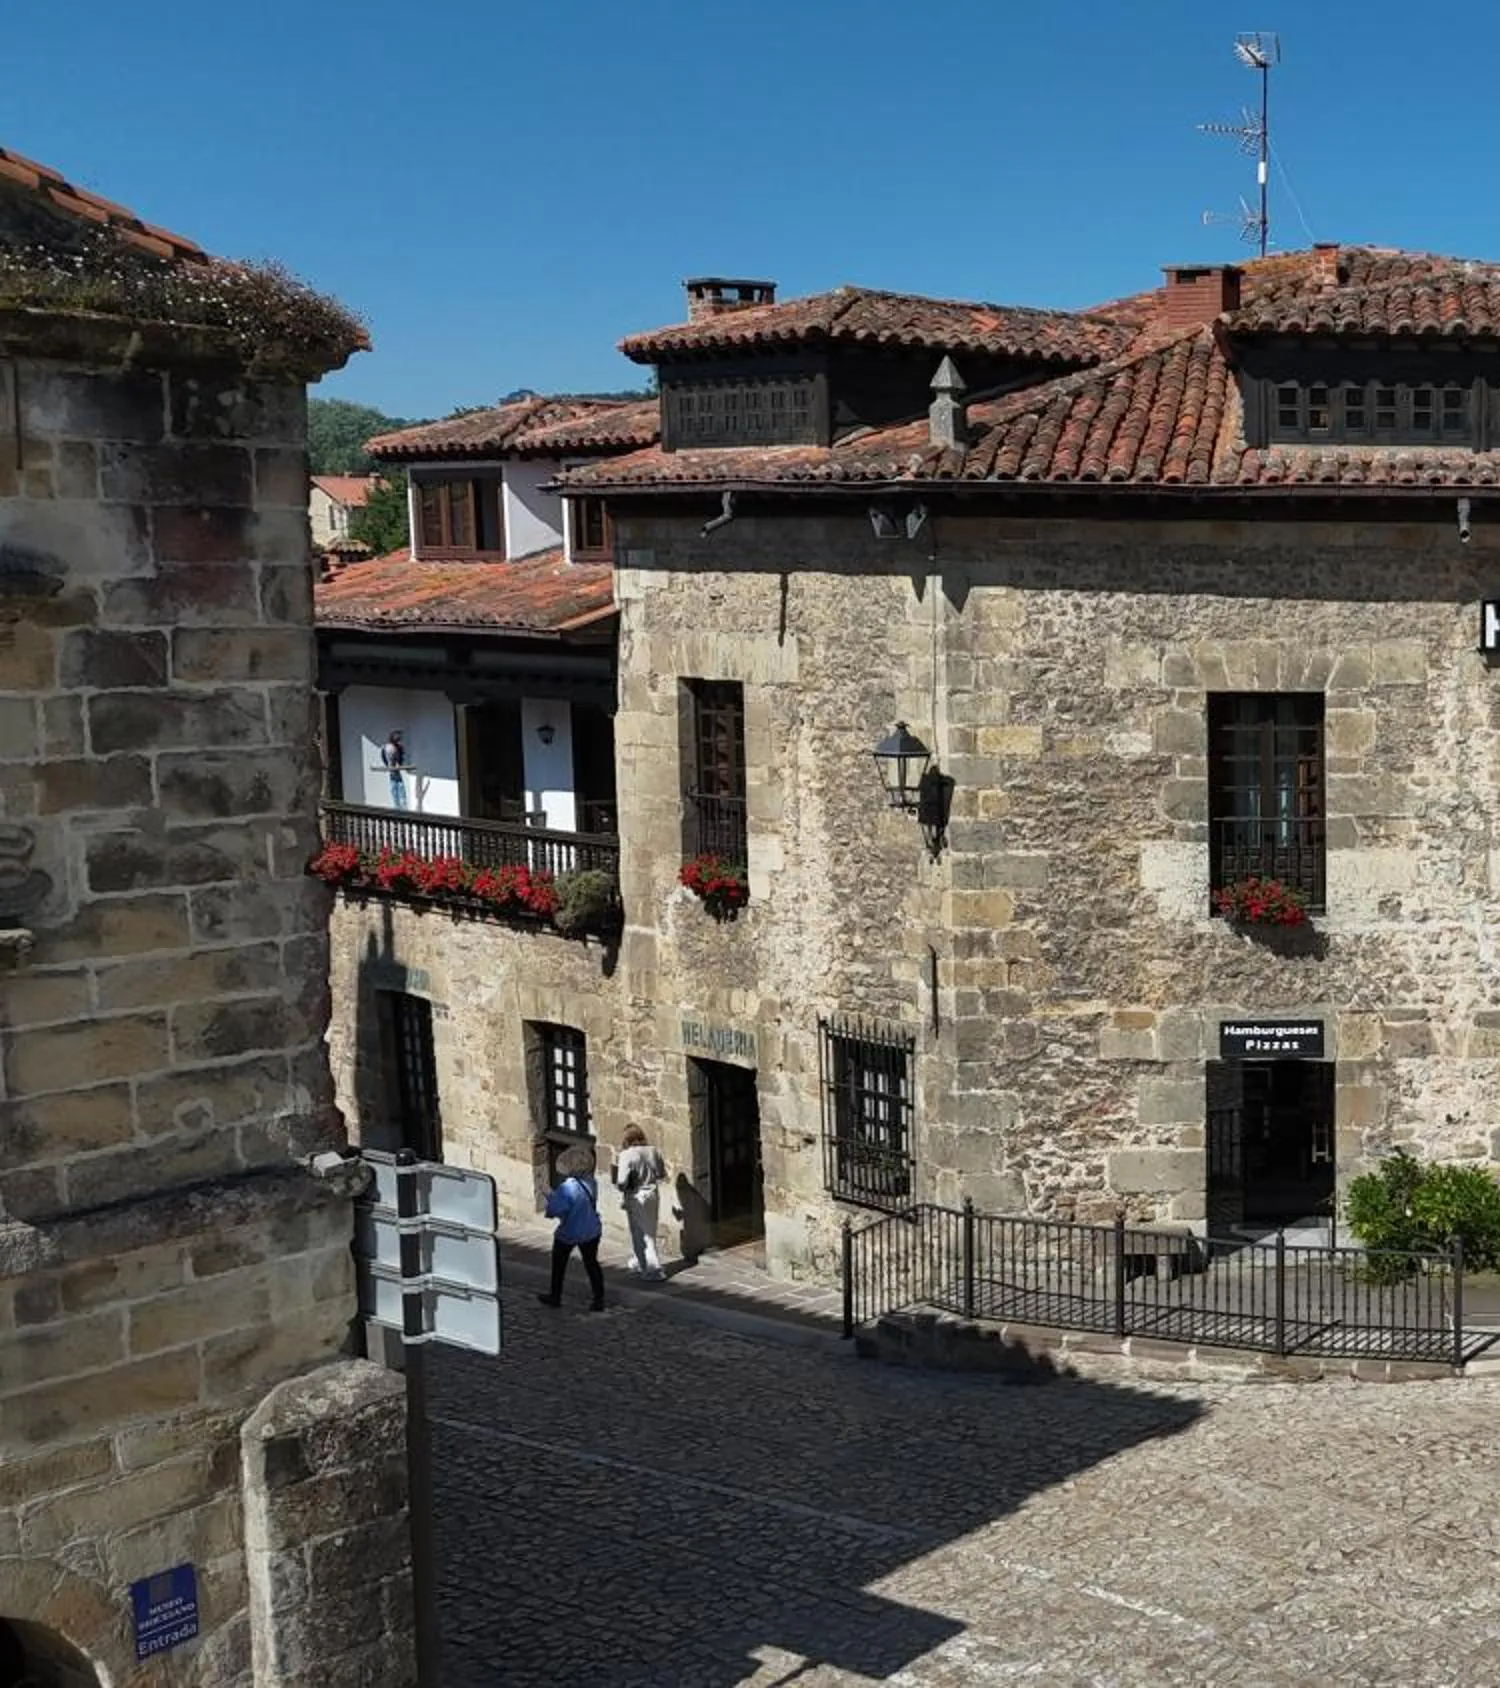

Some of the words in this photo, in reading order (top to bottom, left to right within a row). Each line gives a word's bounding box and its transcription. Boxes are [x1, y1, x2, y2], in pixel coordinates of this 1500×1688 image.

[1223, 1025, 1319, 1037] Hamburguesas
[1245, 1039, 1300, 1051] Pizzas
[138, 1622, 197, 1656] Entrada
